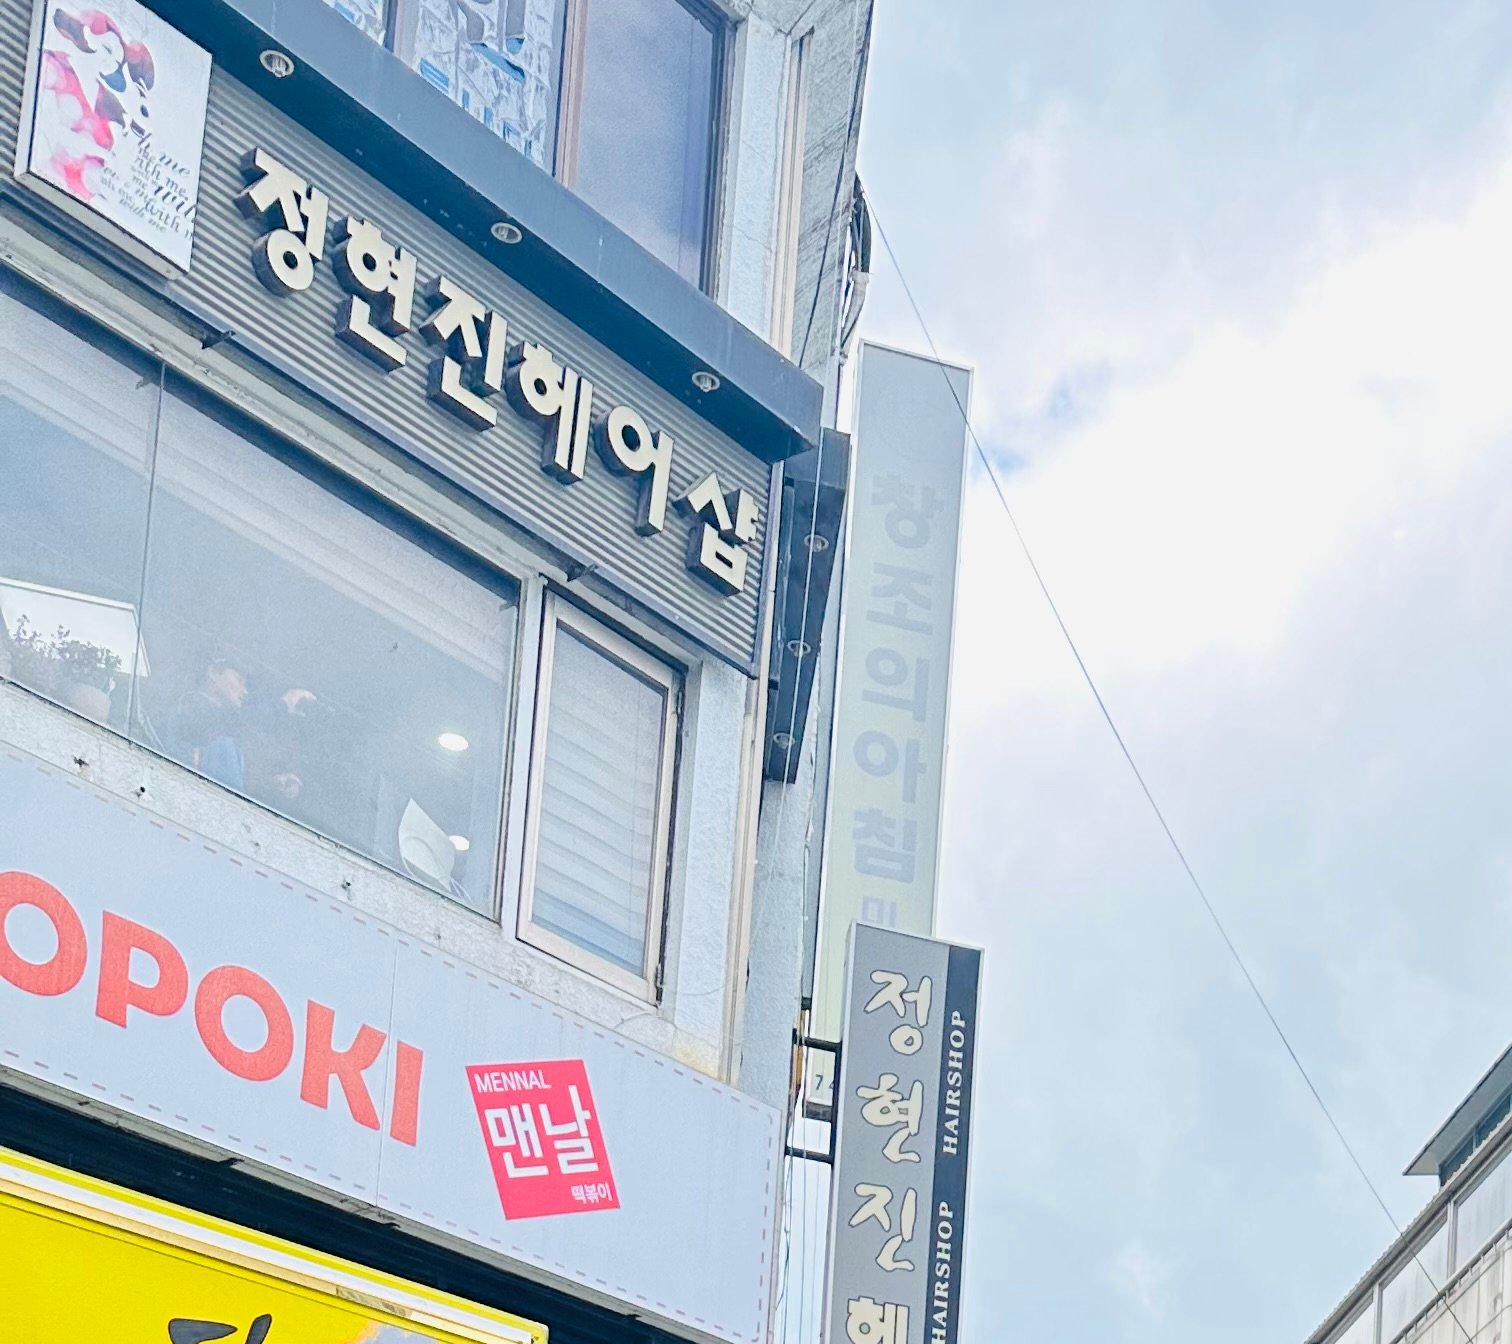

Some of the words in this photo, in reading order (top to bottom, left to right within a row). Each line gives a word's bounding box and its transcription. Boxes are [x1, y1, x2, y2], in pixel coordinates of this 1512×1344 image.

[234, 147, 760, 596] 정현진헤어샵
[474, 1069, 552, 1093] MENNAL
[942, 1009, 967, 1155] HAIRSHOP
[484, 1085, 600, 1178] 맨날
[571, 1182, 613, 1204] 떡볶이
